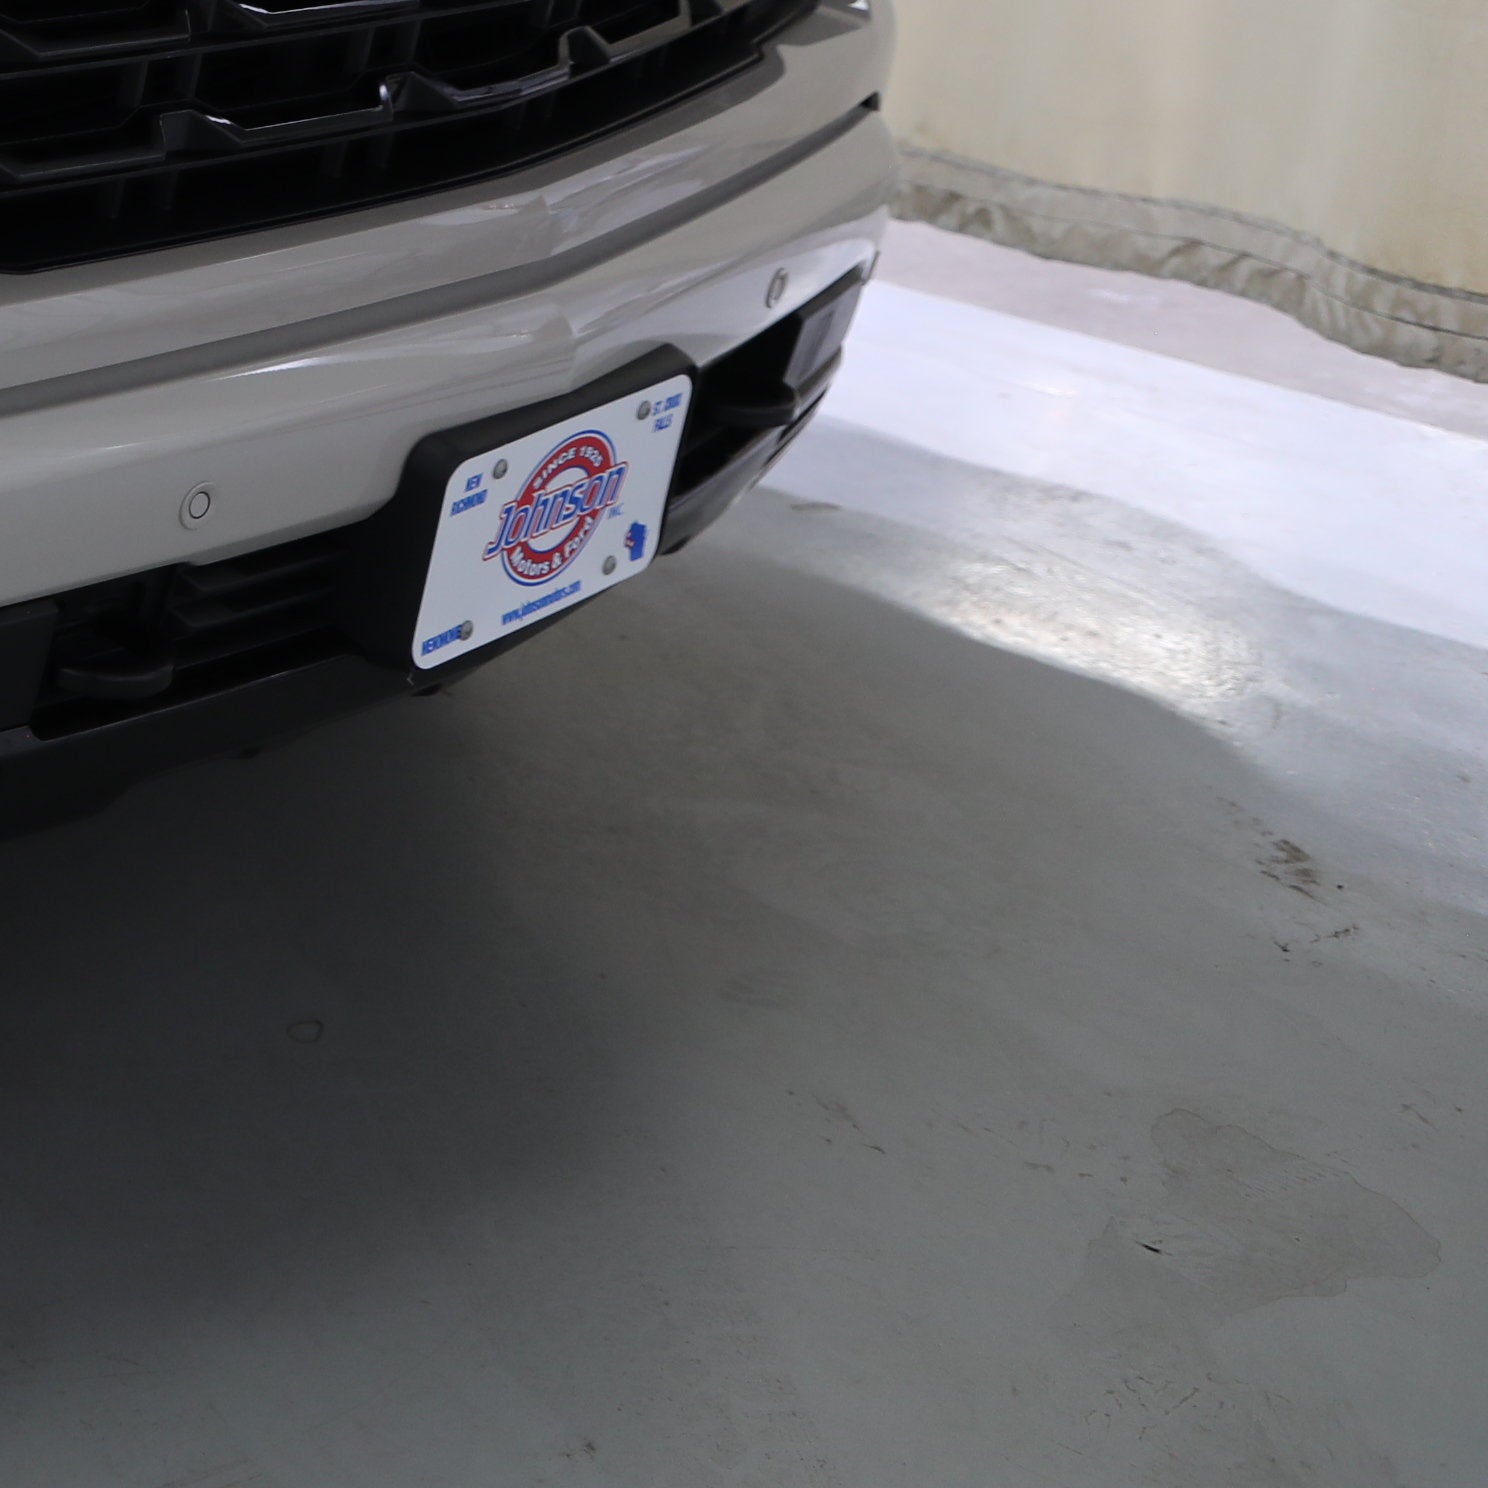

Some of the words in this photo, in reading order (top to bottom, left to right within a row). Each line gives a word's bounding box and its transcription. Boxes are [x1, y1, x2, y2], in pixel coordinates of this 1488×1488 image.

[533, 446, 578, 490] SINCE
[482, 461, 629, 561] Johnson
[510, 546, 551, 576] Motors
